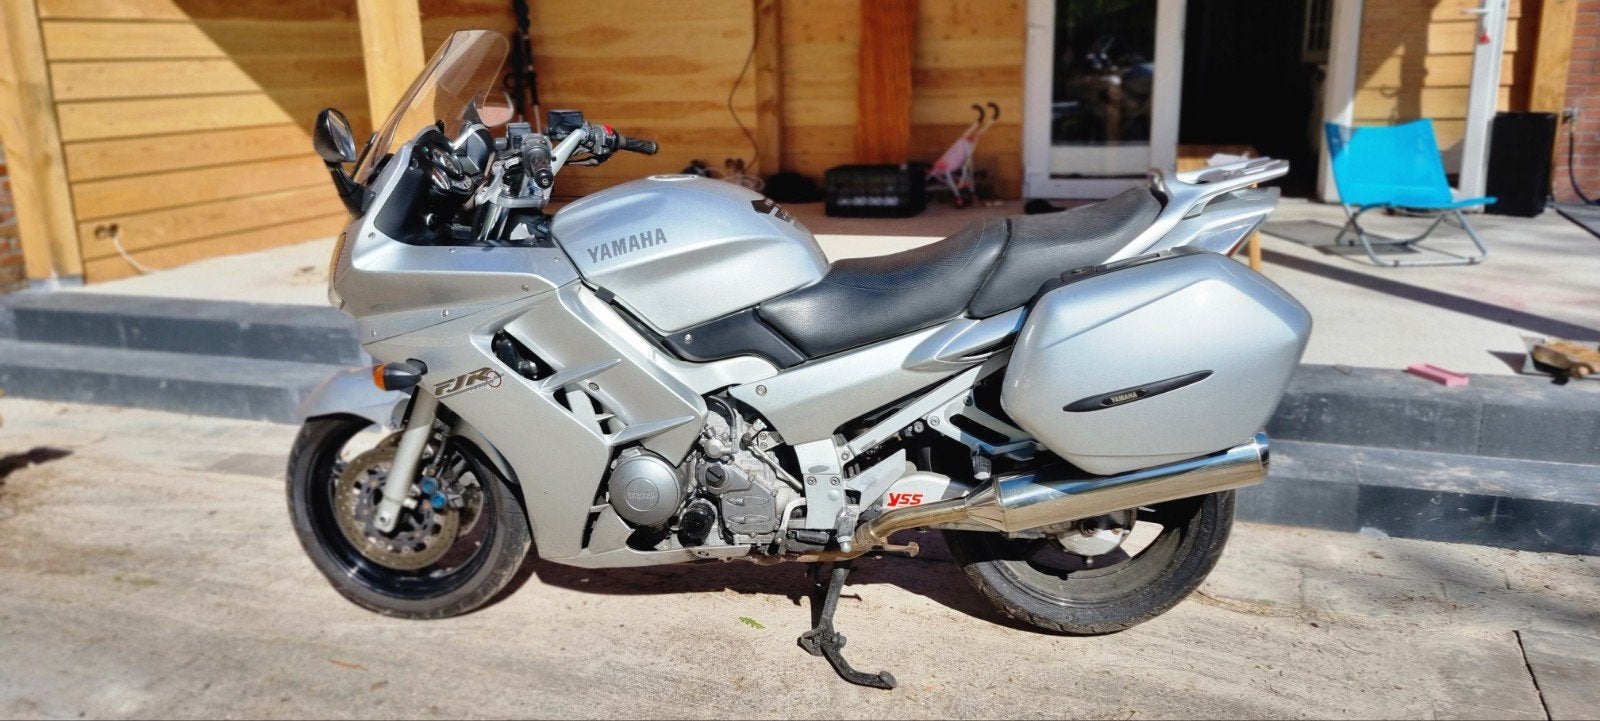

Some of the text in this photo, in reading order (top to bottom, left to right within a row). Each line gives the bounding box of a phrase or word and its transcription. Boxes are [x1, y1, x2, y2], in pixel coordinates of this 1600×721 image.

[587, 228, 668, 263] YAMAHA
[433, 367, 492, 396] FJR
[1111, 391, 1138, 403] YAMAHA
